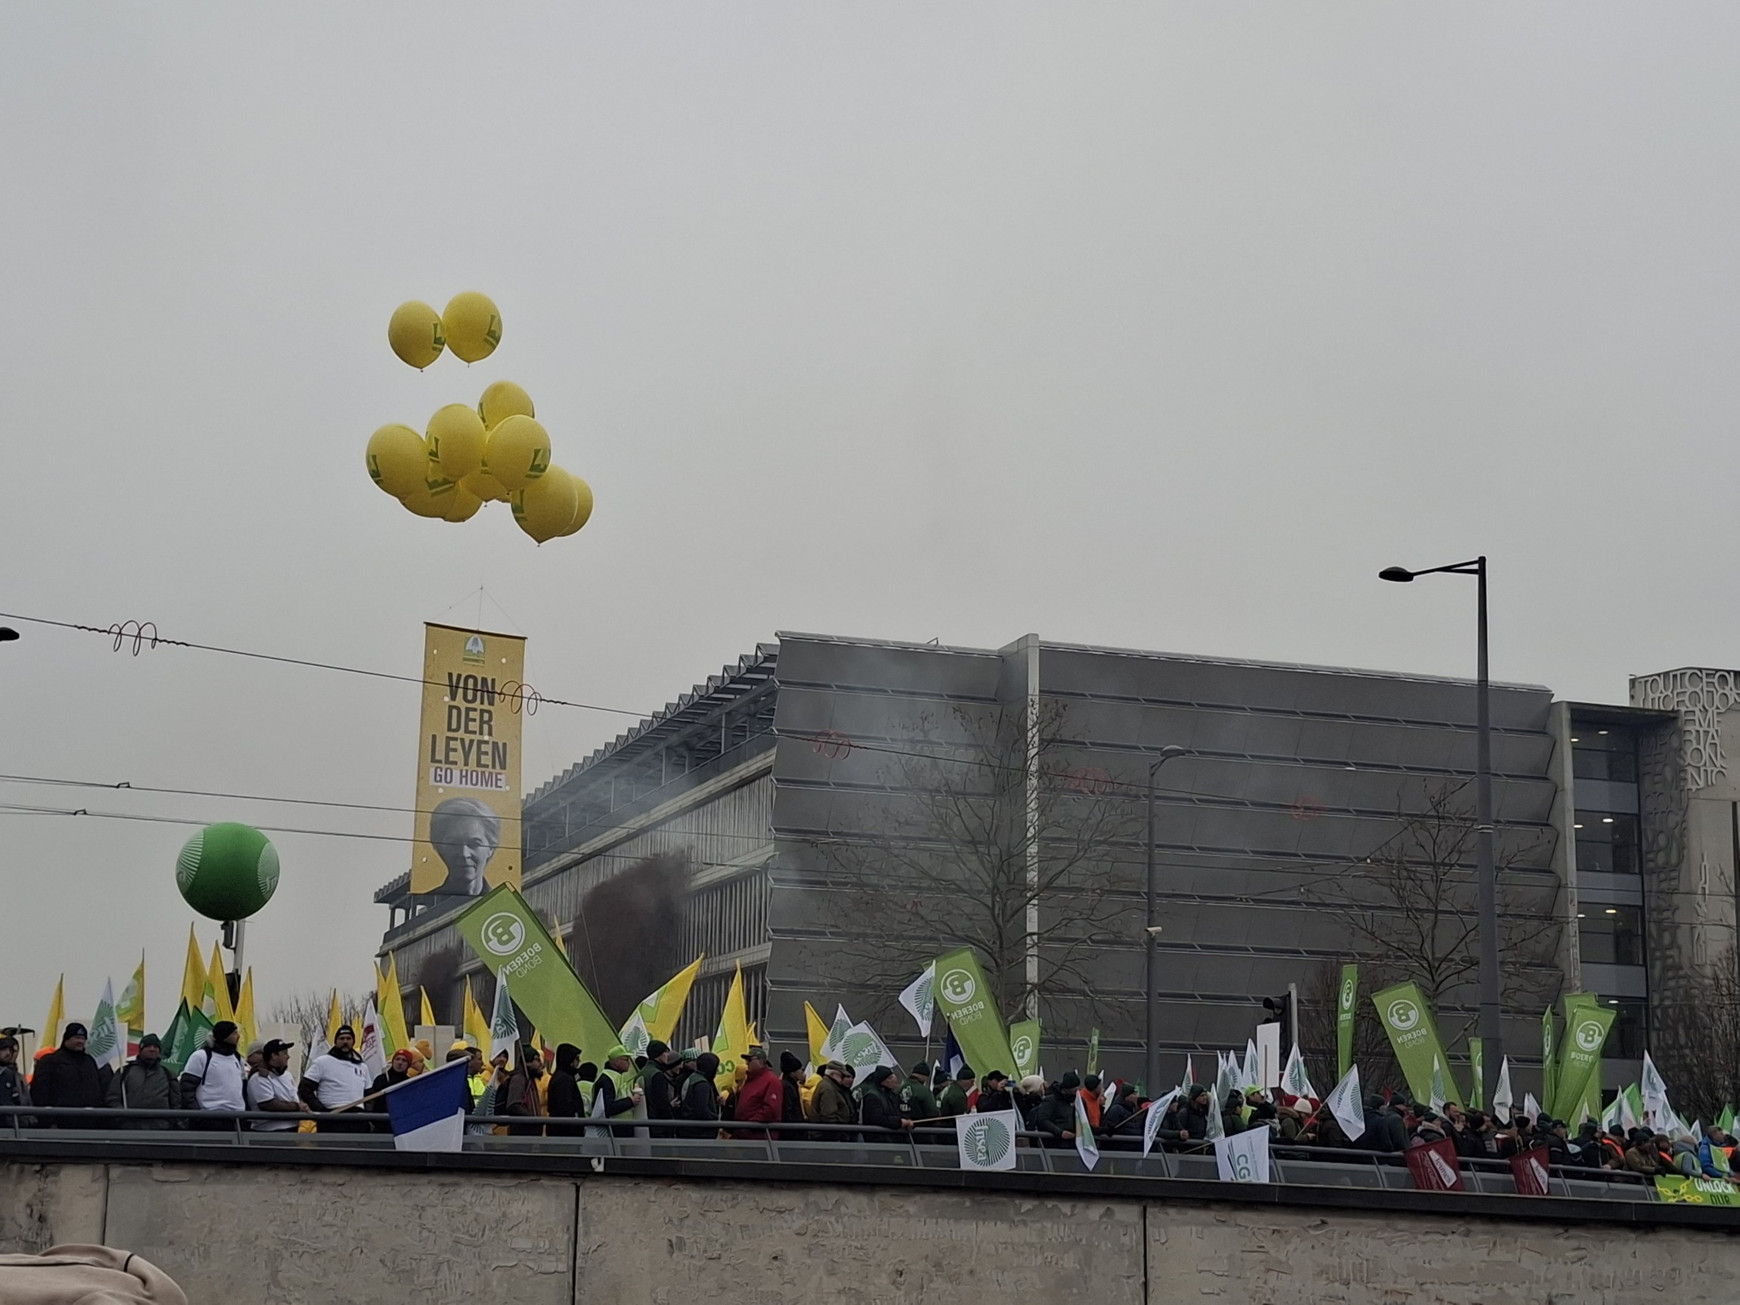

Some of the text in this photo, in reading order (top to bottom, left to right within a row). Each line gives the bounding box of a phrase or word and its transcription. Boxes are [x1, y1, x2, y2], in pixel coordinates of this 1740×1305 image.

[447, 671, 496, 707] VON
[446, 705, 494, 738] DER
[430, 733, 508, 771] LEYEN
[433, 766, 504, 789] GO HOME
[1236, 1153, 1251, 1180] CG
[1693, 1177, 1736, 1194] UNLOCK
